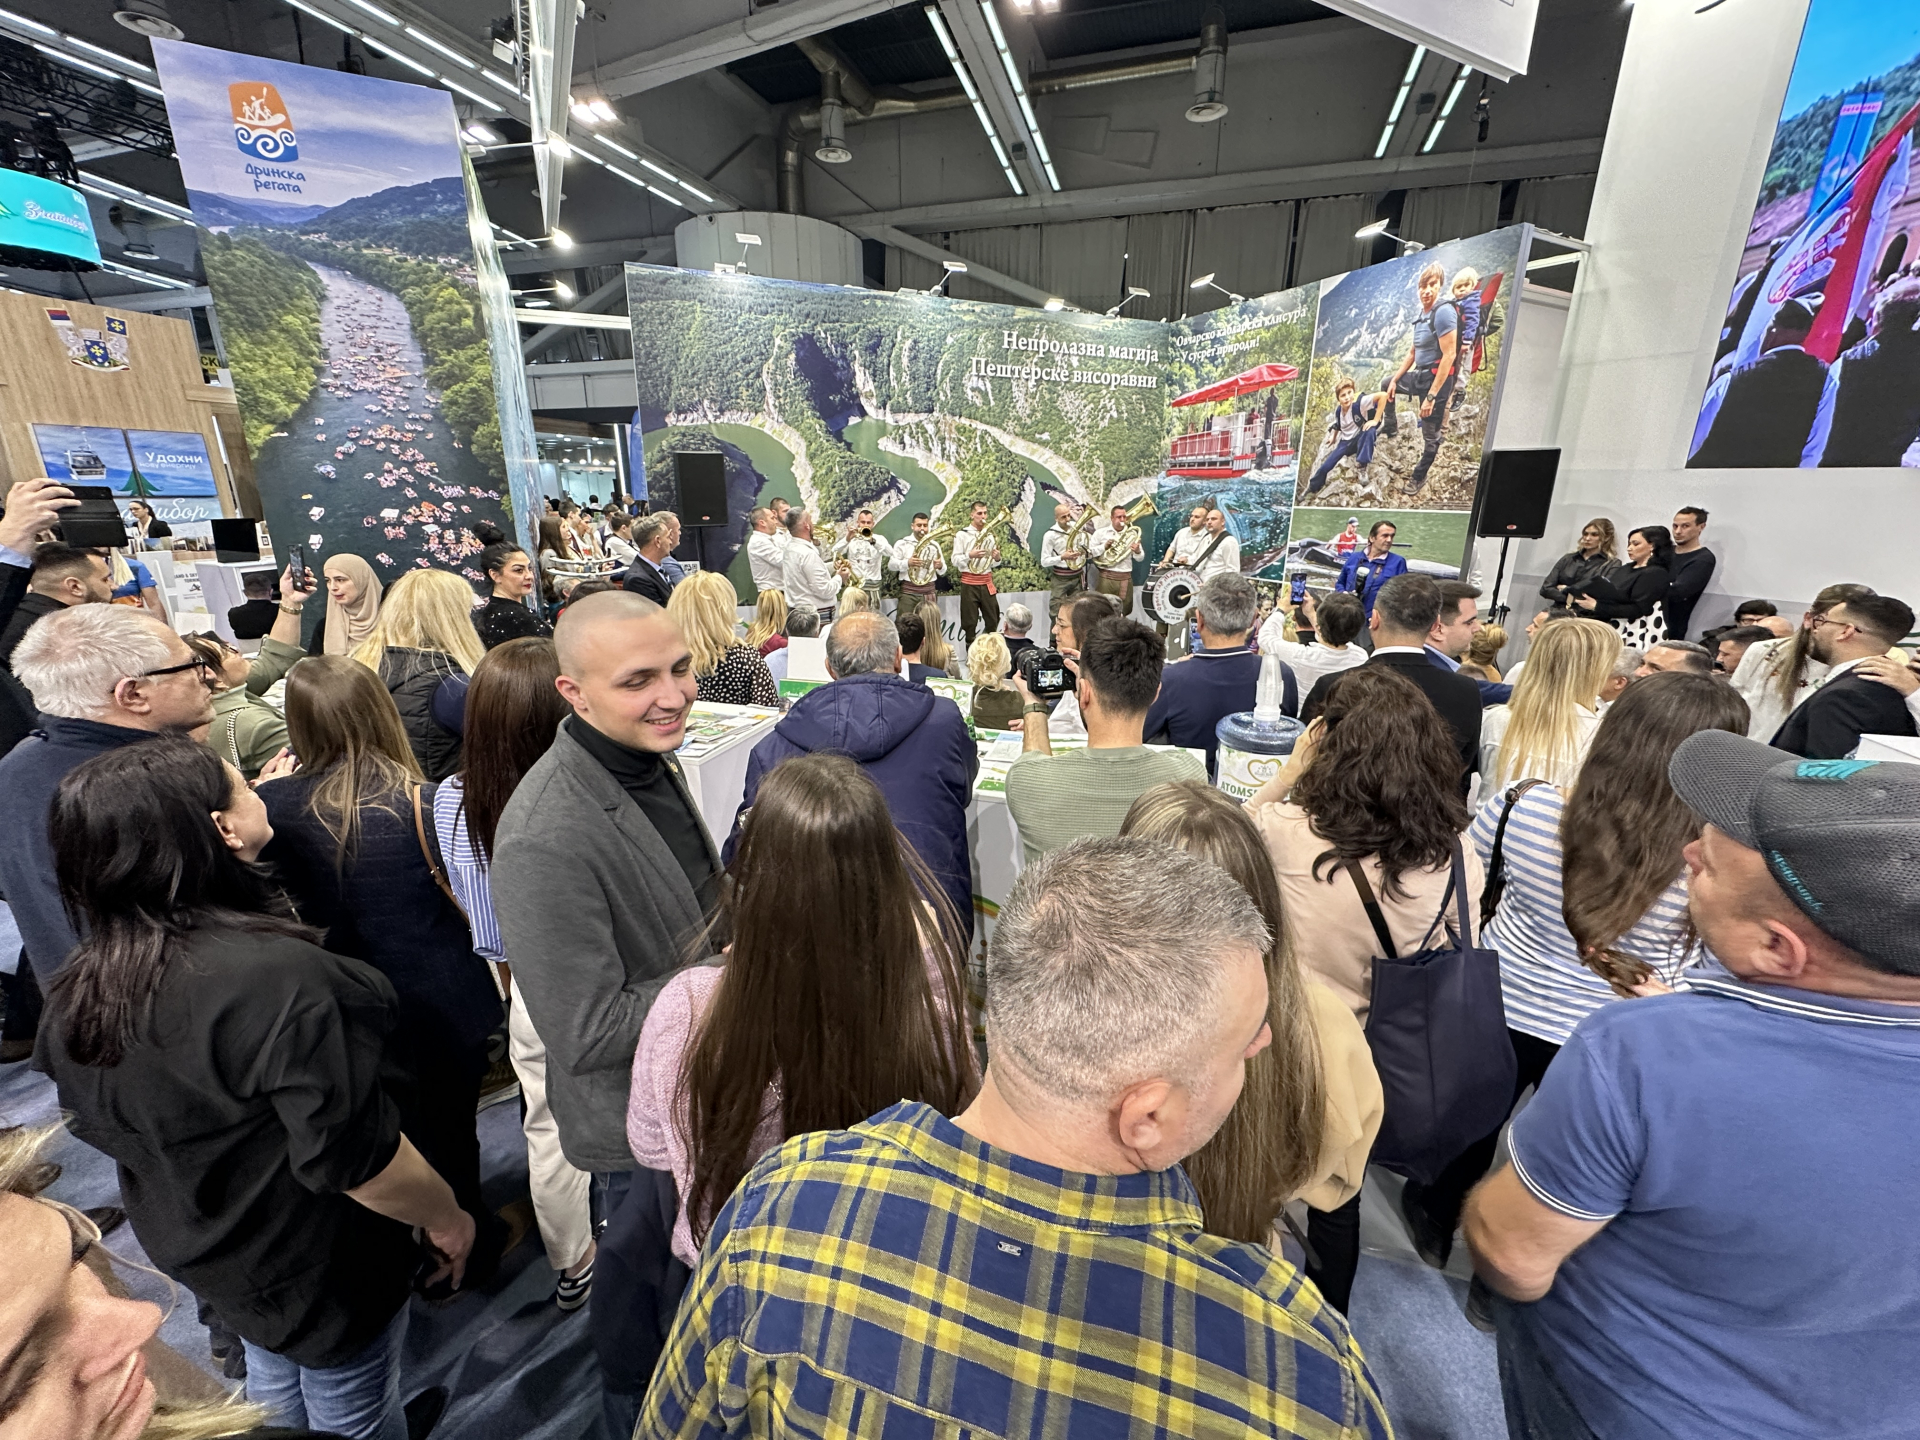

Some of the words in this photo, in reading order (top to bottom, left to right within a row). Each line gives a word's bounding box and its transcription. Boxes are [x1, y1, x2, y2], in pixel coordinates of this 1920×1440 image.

[245, 163, 306, 181] Дринска
[253, 179, 302, 194] регата
[1002, 330, 1105, 358] Непролазна
[1108, 344, 1159, 366] магија
[970, 357, 1069, 386] Пештерске
[1073, 369, 1158, 390] висоравни
[145, 452, 203, 464] Удахни
